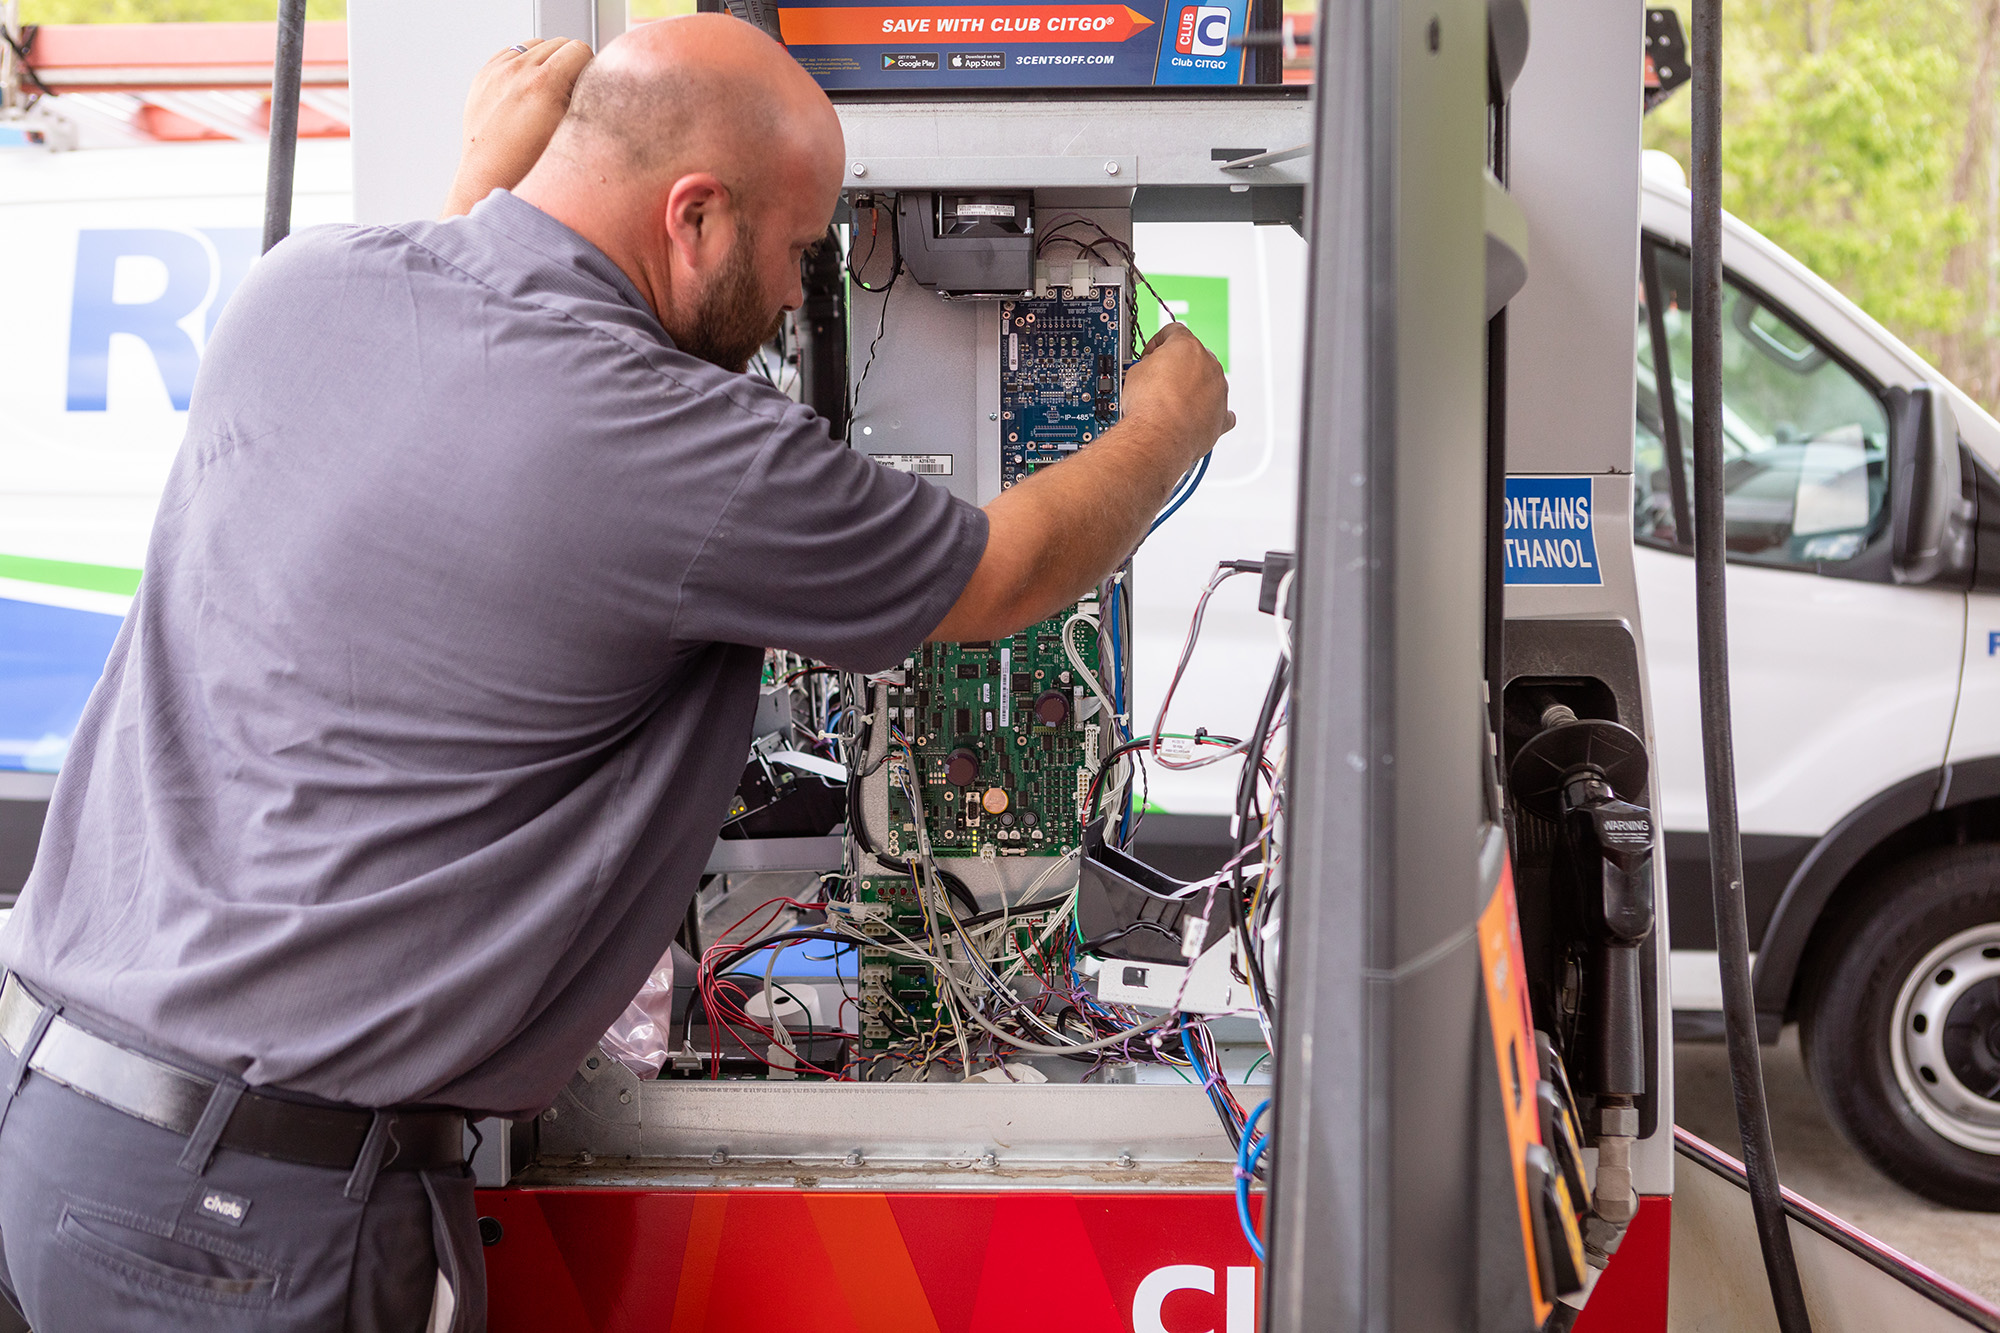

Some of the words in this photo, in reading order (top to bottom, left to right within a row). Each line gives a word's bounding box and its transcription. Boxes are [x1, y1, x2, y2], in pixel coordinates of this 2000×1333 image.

[881, 19, 931, 33] SAVE
[936, 18, 985, 32] WITH
[990, 18, 1041, 32] CLUB
[1180, 13, 1194, 45] CLUB
[1197, 15, 1227, 46] C
[898, 60, 921, 68] Google
[922, 60, 936, 68] Play
[965, 60, 981, 68] App
[982, 59, 1001, 67] Store
[1015, 56, 1115, 65] 3CENTSOFF.COM
[1171, 57, 1193, 67] Club
[1504, 496, 1589, 530] ONTAINS
[1504, 538, 1593, 568] THANOL
[1603, 820, 1650, 831] WARNING
[1132, 1264, 1256, 1333] CI
